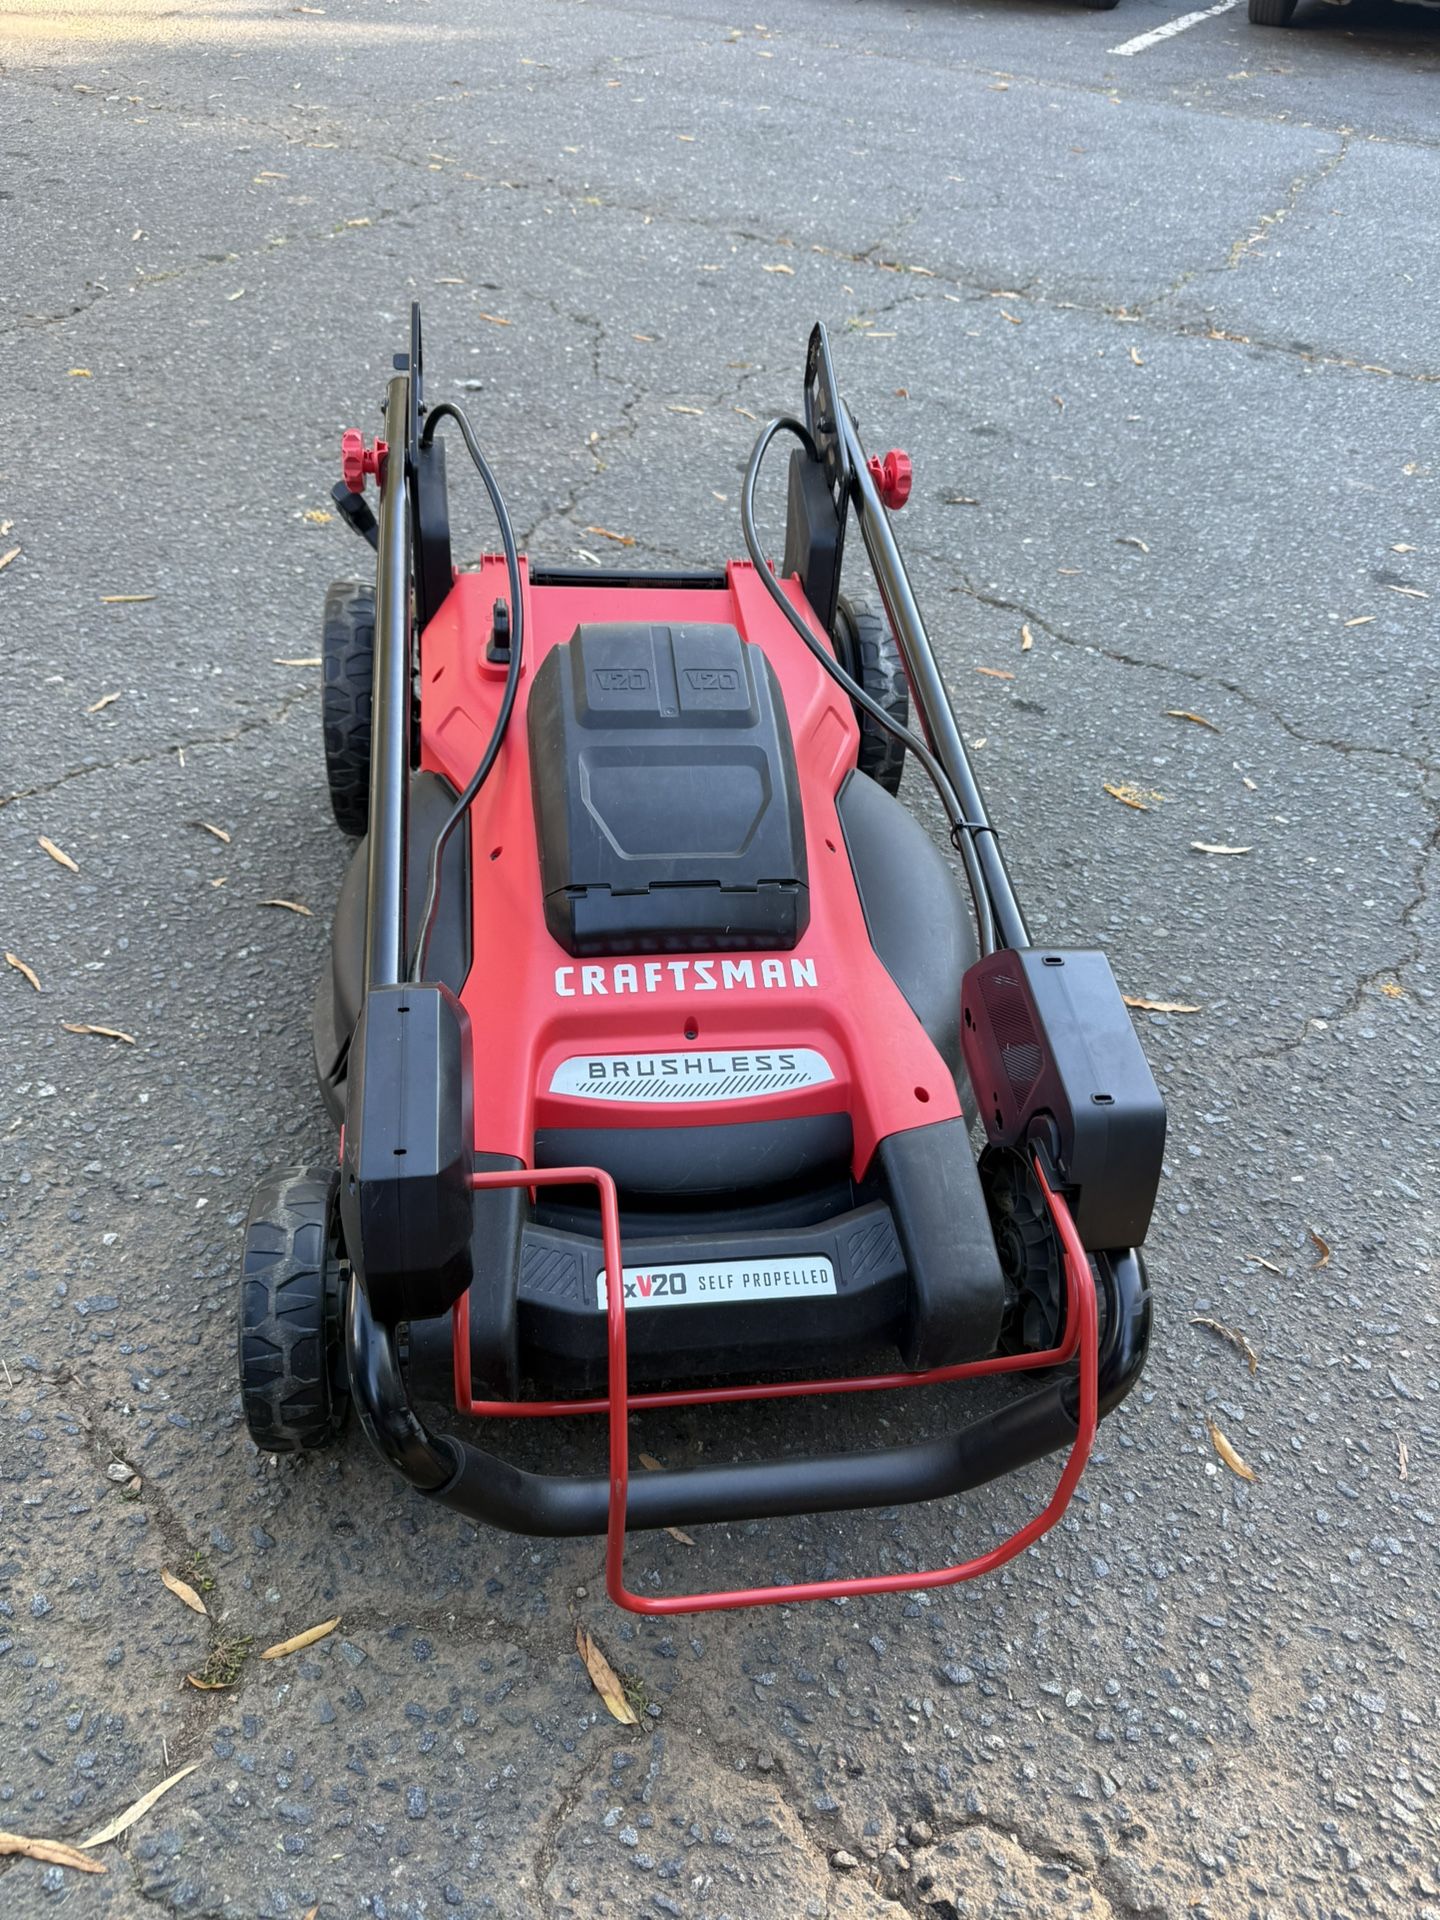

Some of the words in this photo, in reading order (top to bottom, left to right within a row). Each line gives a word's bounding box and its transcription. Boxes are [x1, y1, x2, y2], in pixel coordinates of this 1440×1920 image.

[594, 671, 647, 691] V20
[684, 671, 737, 691] V20
[554, 958, 819, 997] CRAFTSMAN
[588, 1054, 796, 1079] BRUSHLESS
[606, 1272, 687, 1299] xV20
[698, 1274, 734, 1291] SELF
[742, 1269, 829, 1288] PROPELLED
